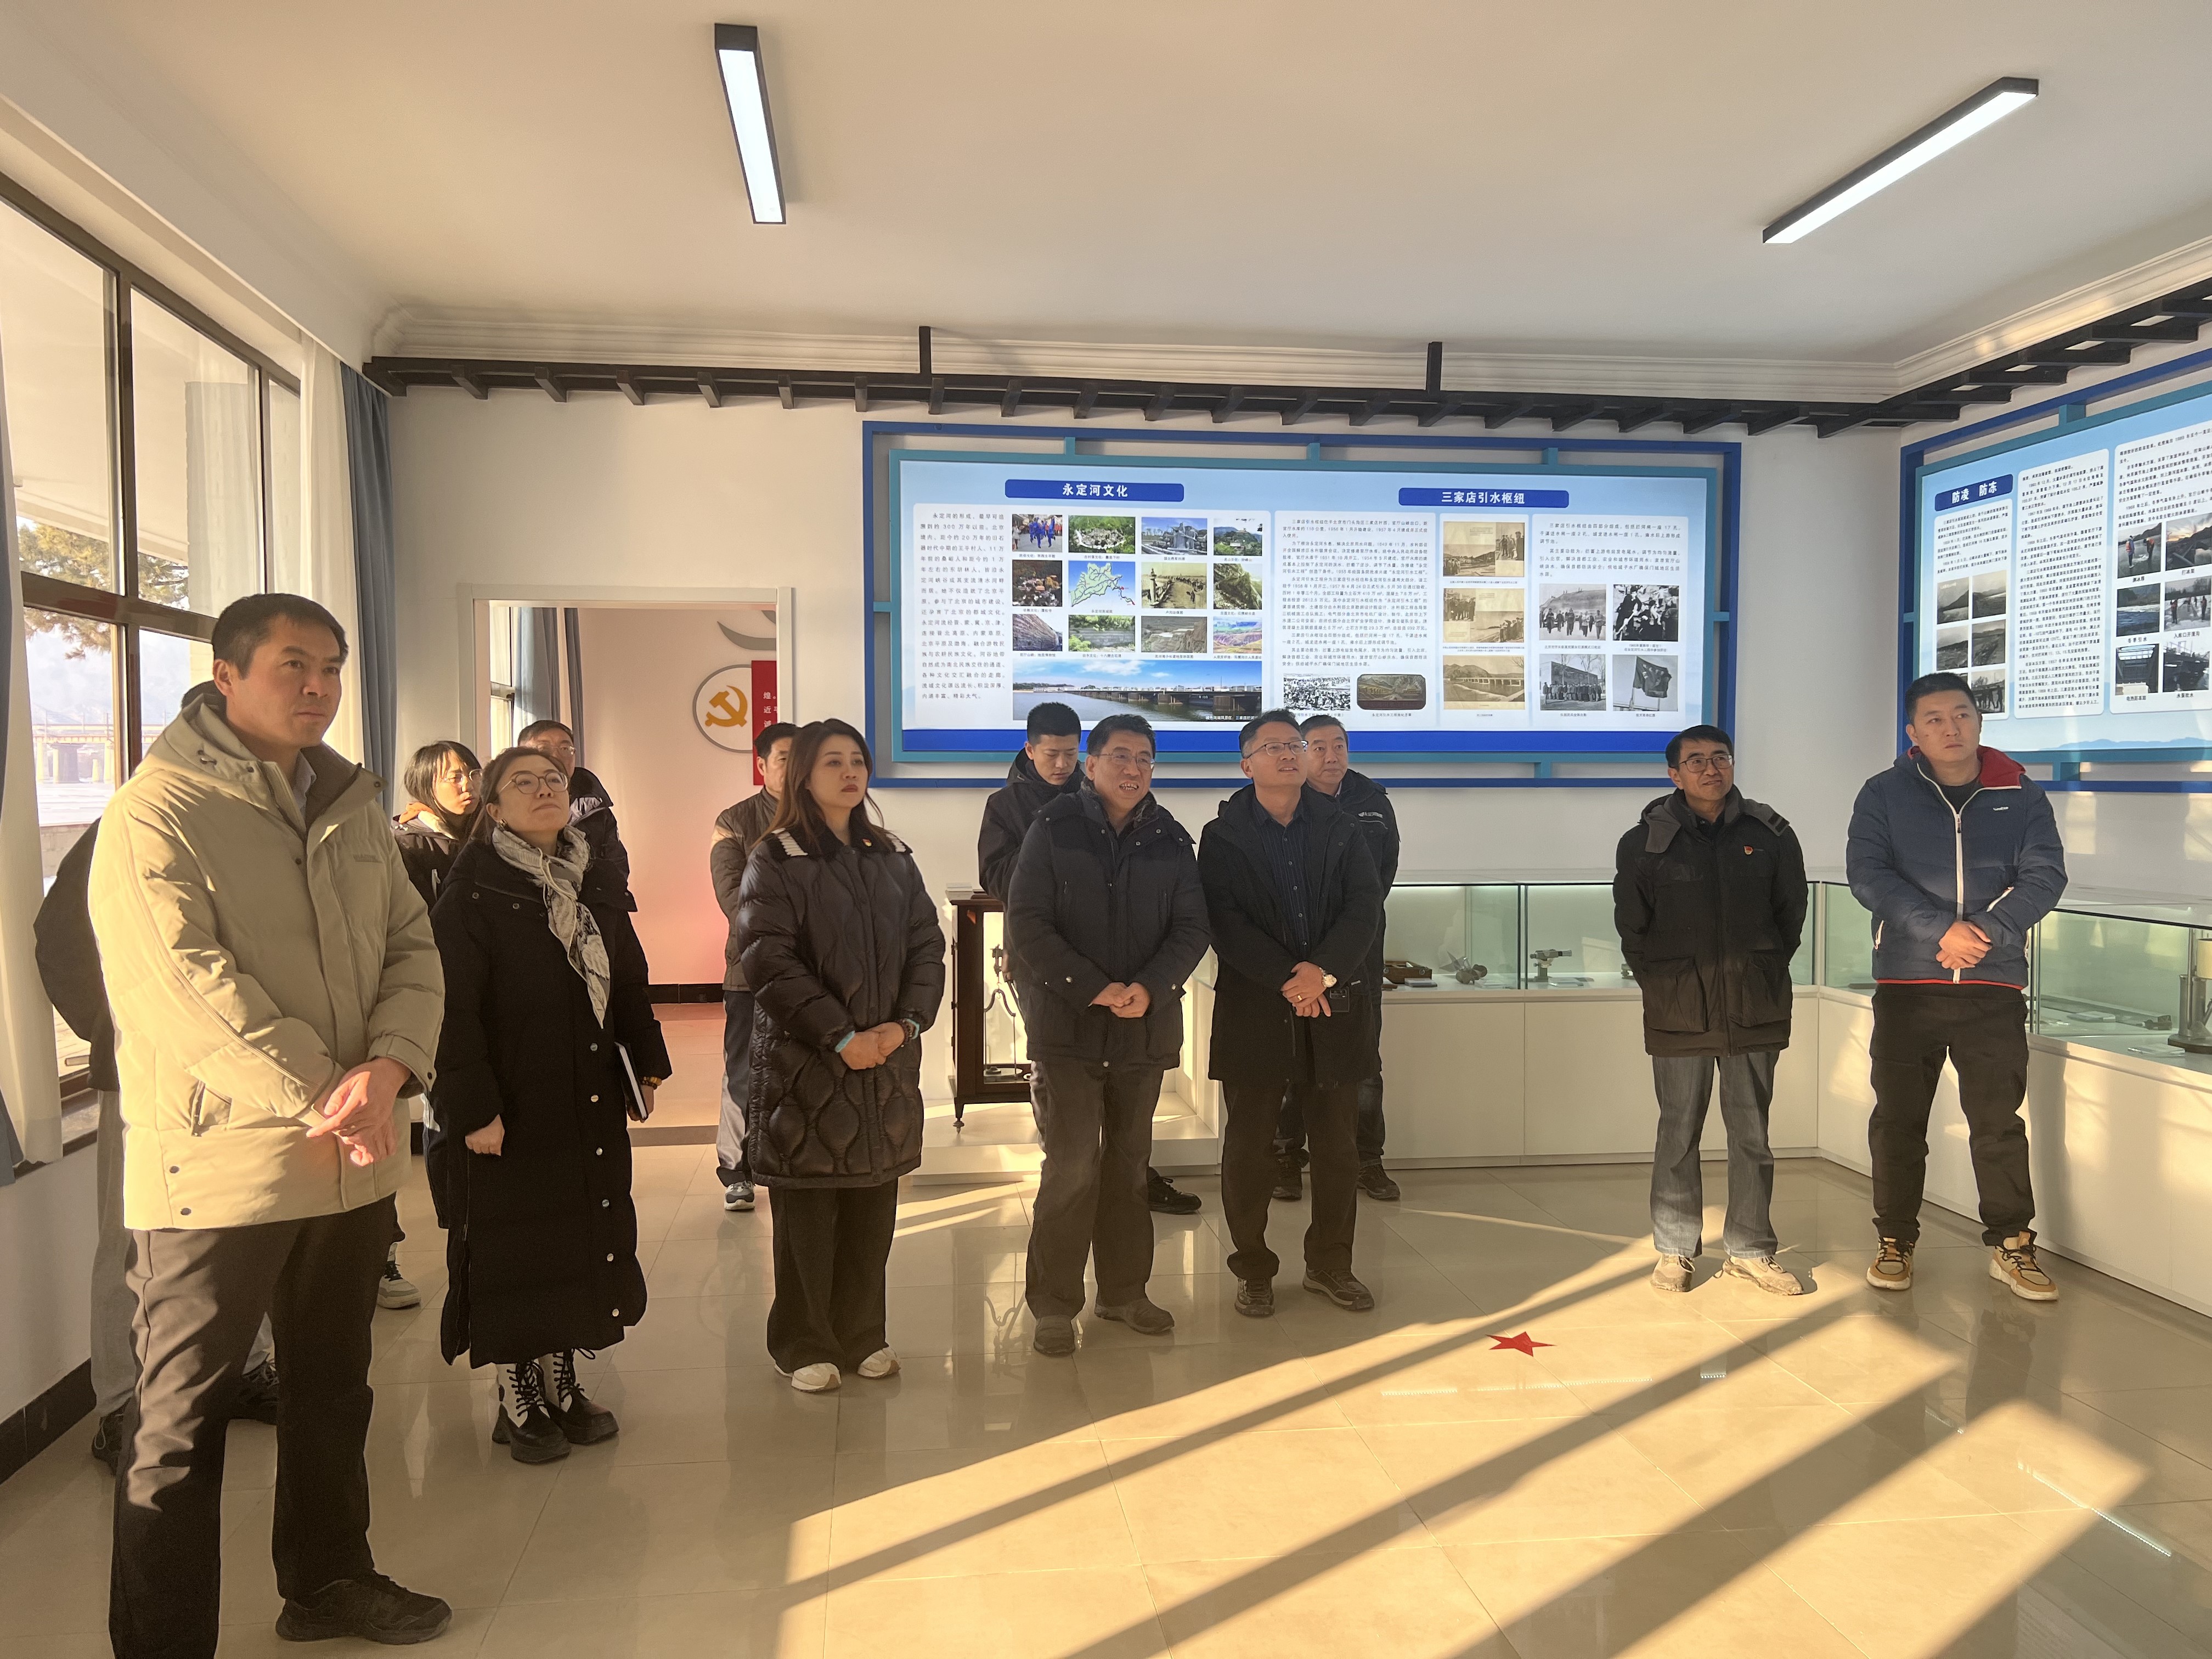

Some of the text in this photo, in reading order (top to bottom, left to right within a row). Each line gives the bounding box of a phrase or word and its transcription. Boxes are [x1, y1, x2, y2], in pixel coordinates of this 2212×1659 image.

[1062, 483, 1128, 498] 永定河文化
[1441, 491, 1525, 504] 三家店引水枢纽
[1951, 481, 1997, 504] 防凌 防冻
